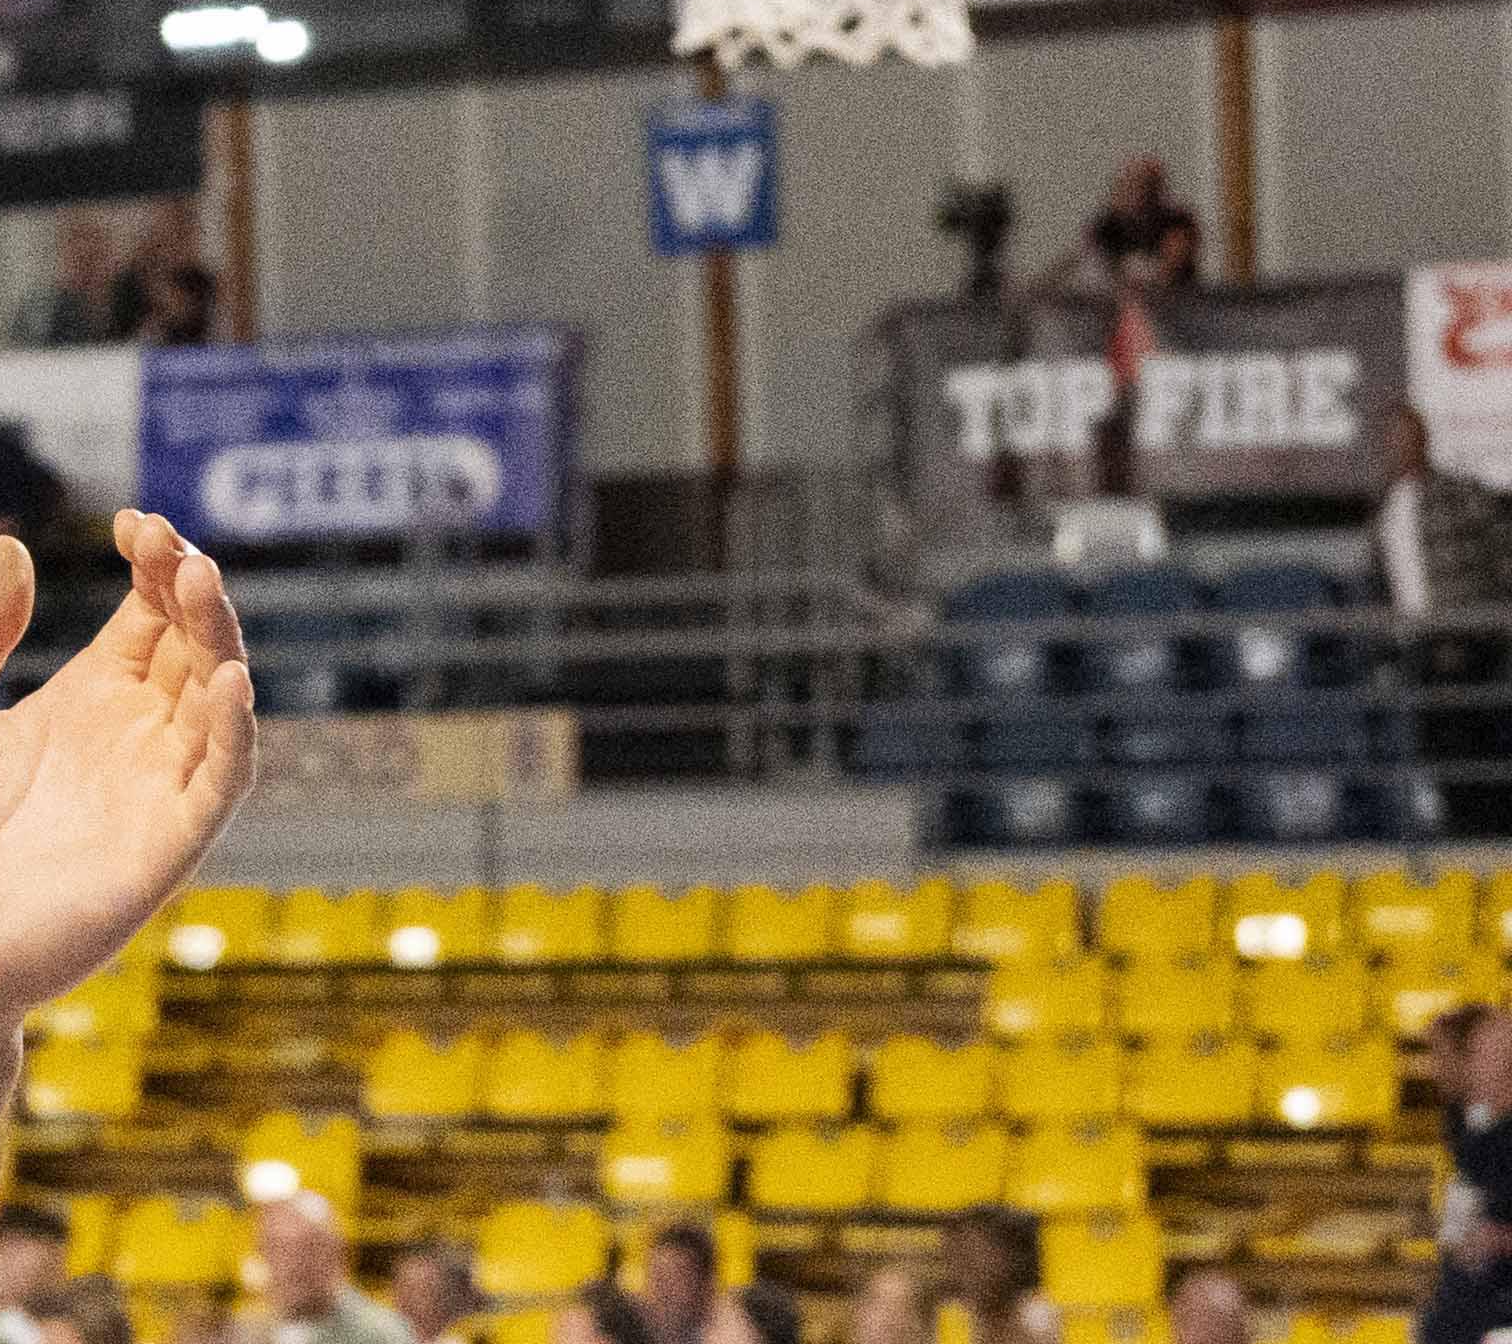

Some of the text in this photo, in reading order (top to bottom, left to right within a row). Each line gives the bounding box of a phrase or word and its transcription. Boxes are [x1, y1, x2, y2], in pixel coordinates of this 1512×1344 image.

[663, 150, 762, 231] W
[945, 351, 1356, 455] TOP FIRE
